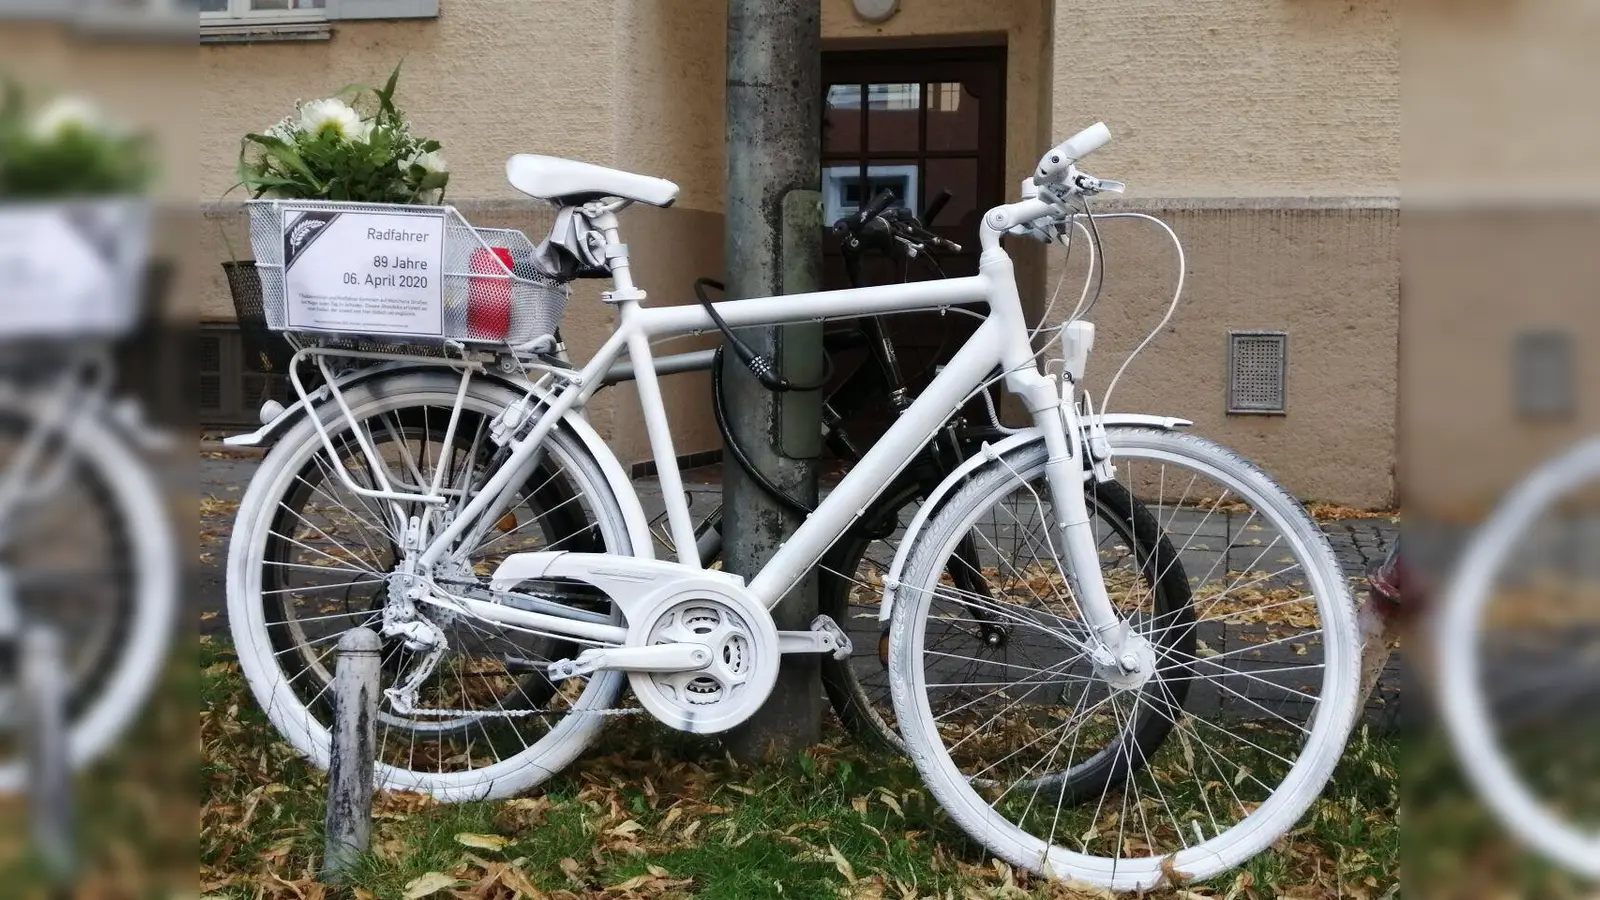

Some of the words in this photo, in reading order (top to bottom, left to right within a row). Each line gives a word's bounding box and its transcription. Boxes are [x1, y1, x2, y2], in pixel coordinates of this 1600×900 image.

[367, 227, 430, 242] Radfahrer
[373, 255, 388, 268] 89
[392, 256, 428, 270] Jahre
[343, 272, 360, 285] 06.
[364, 273, 396, 289] April
[399, 275, 428, 289] 2020
